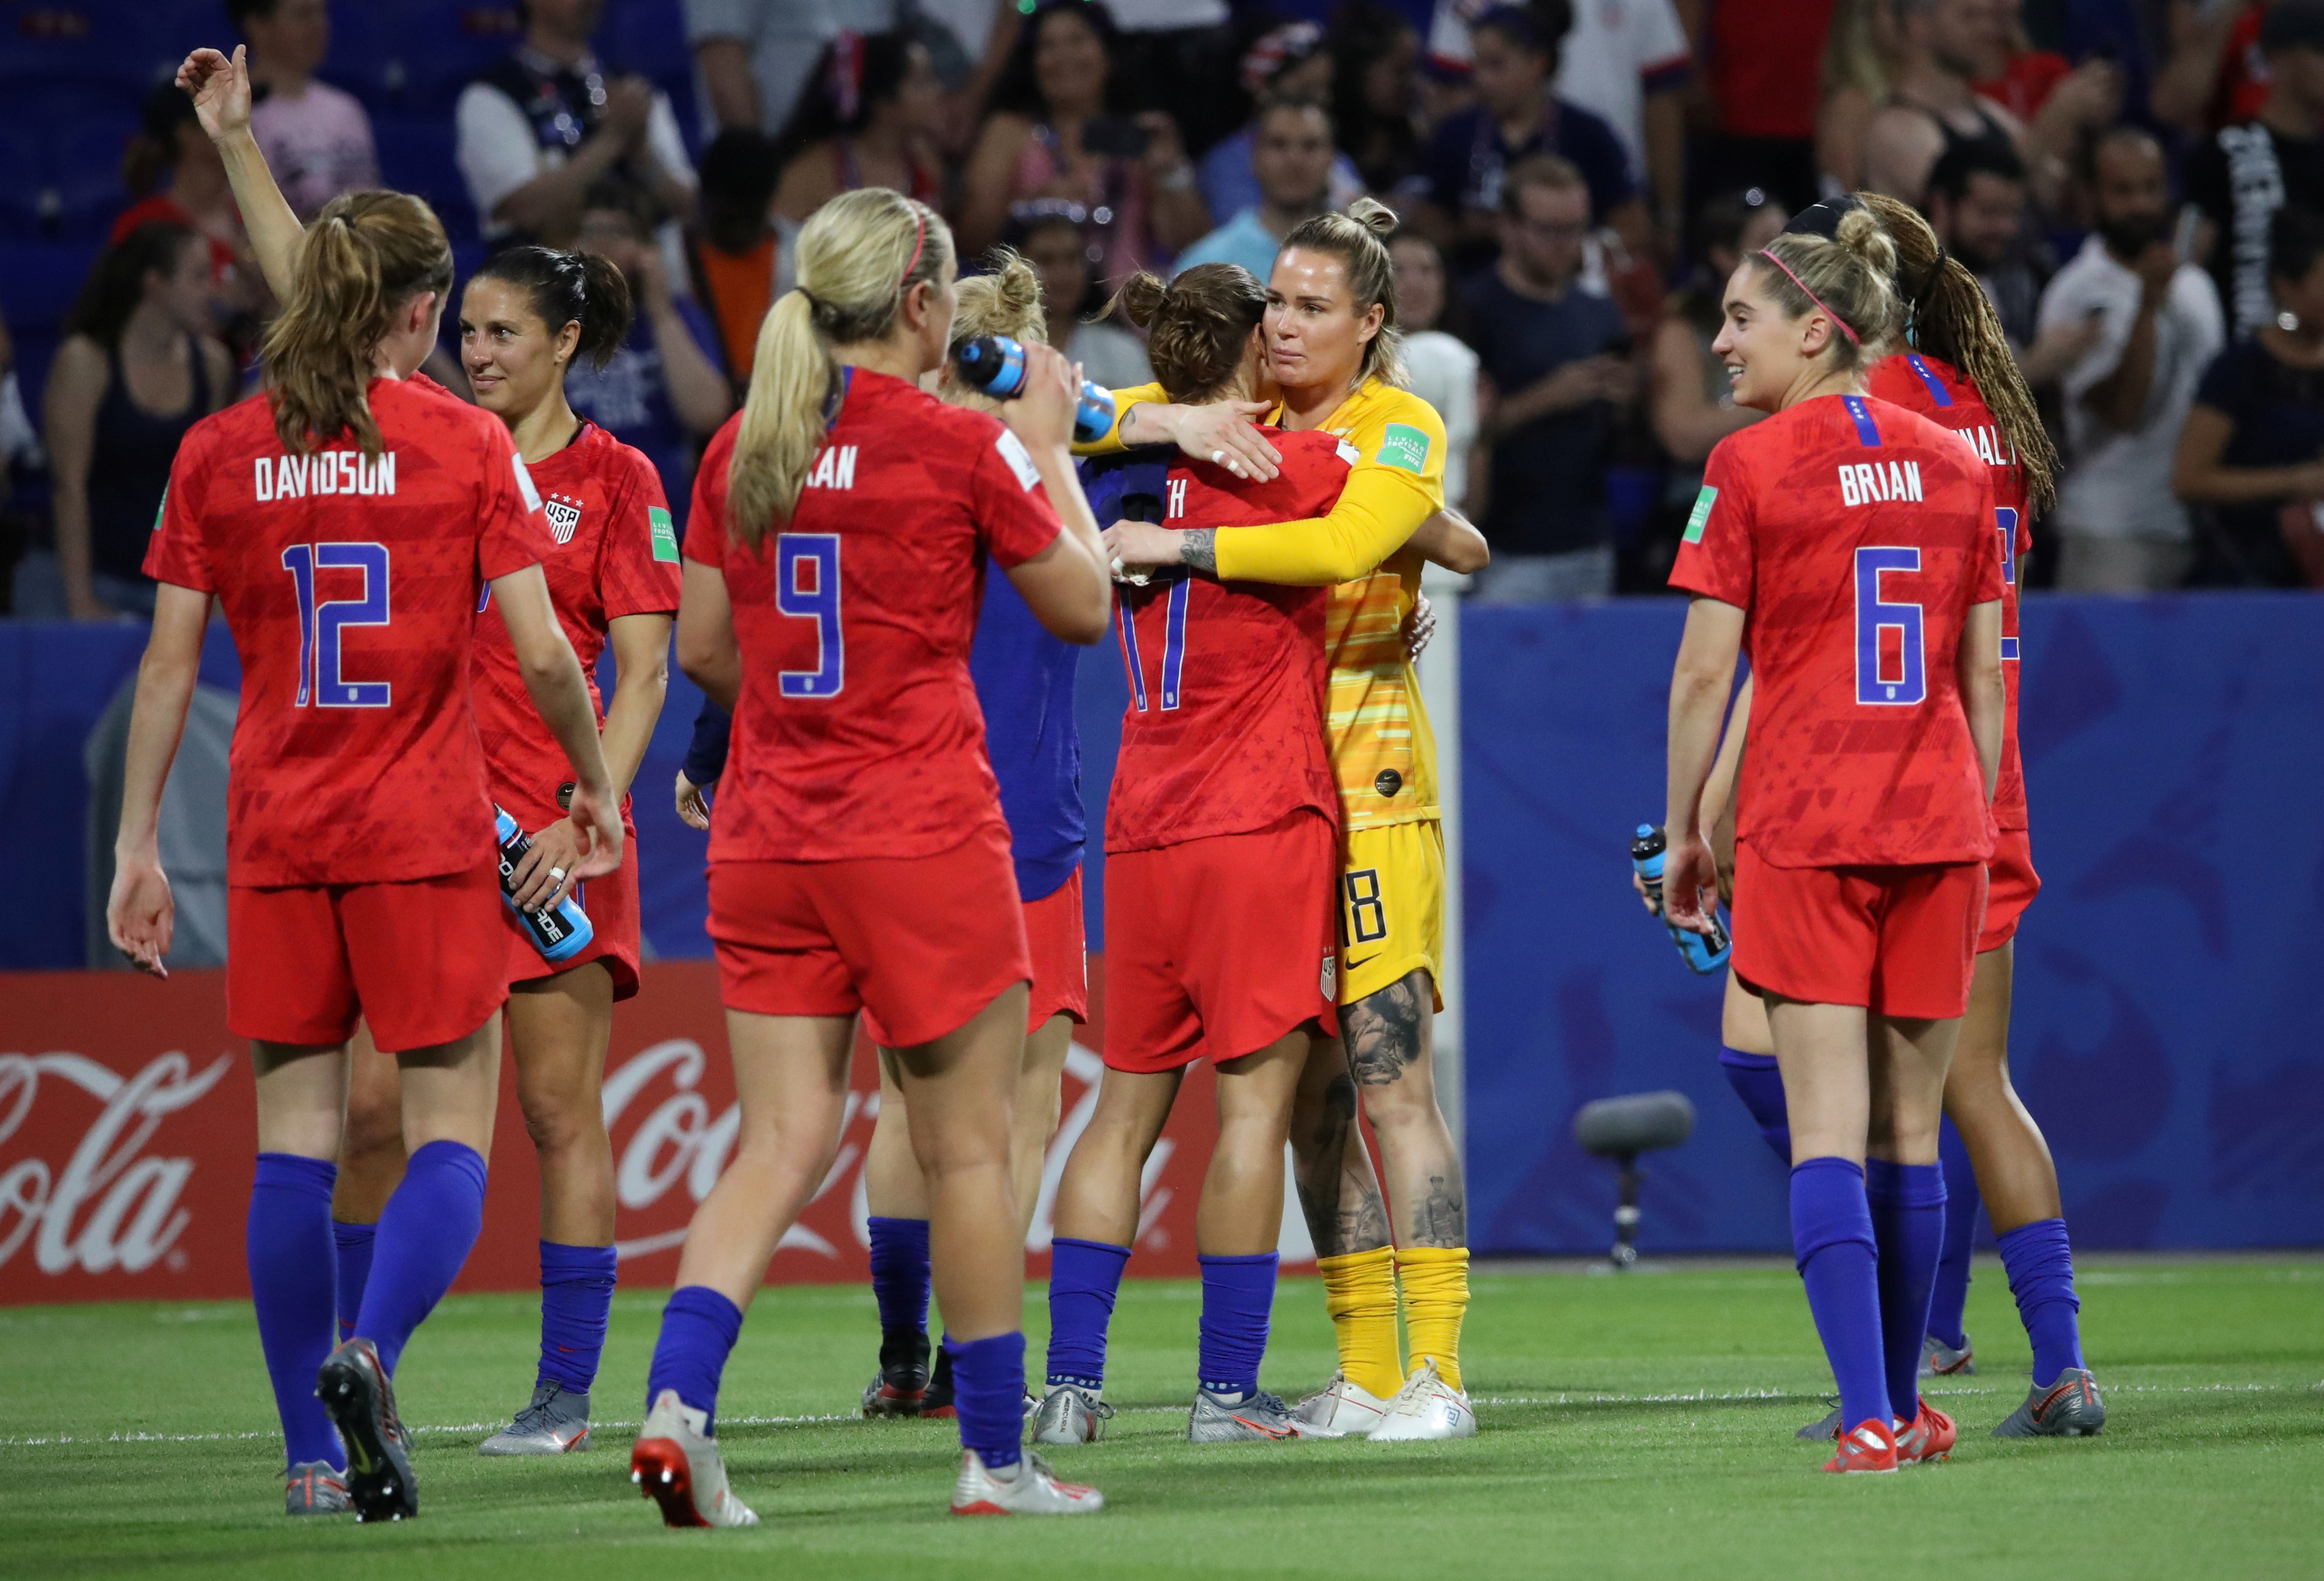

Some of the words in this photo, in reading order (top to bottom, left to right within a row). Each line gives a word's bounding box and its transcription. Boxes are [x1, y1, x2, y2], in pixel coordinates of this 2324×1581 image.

[1387, 441, 1423, 457] FOOTBALL
[1388, 435, 1424, 453] LIVING
[1403, 453, 1420, 467] FIFA
[255, 450, 395, 501] DAVIDSON
[1838, 460, 1923, 507] BRIAN
[547, 503, 577, 523] USA
[281, 541, 391, 708] 12
[775, 532, 845, 699] 9
[1855, 546, 1927, 706] 6
[1059, 1396, 1071, 1434] MERCURIAL
